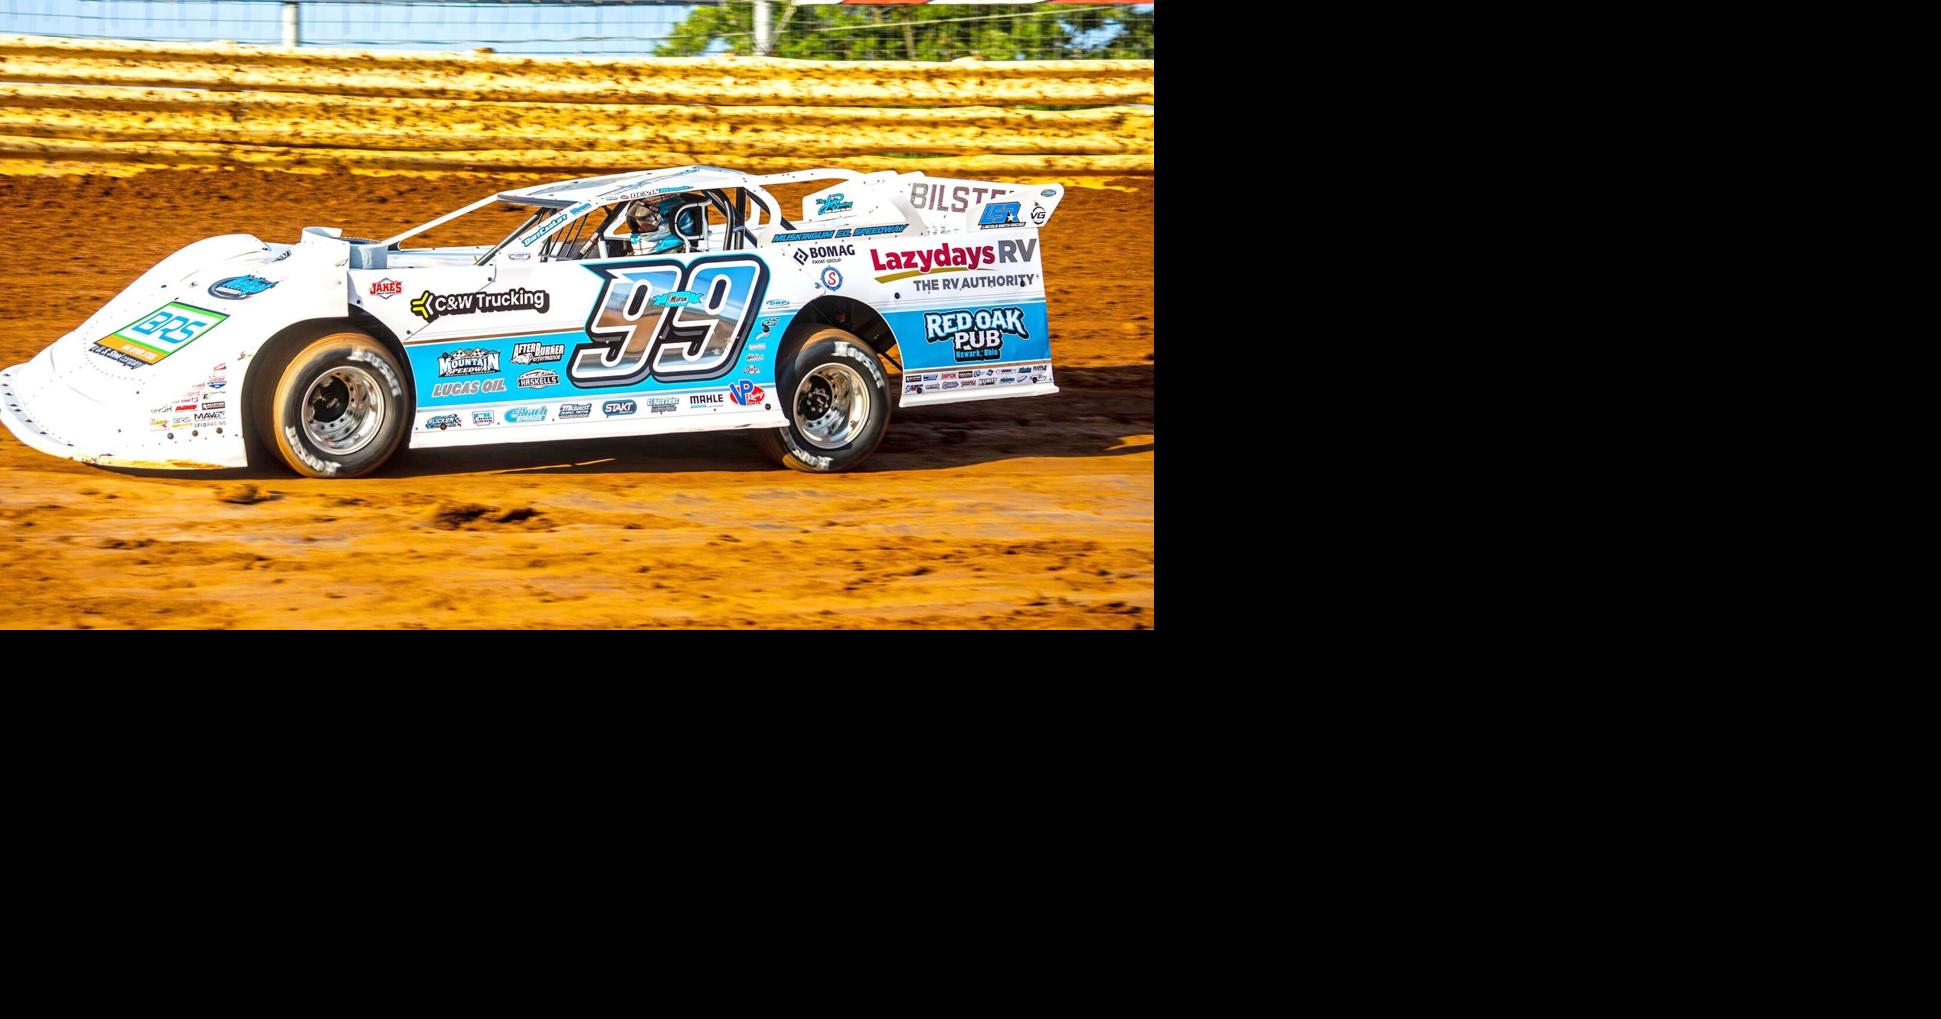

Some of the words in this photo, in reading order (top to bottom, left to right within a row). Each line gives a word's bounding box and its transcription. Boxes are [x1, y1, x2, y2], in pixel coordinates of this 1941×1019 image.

[1030, 211, 1046, 220] VG
[852, 224, 909, 236] SPEEDWAY
[809, 245, 856, 259] BOMAG
[870, 242, 996, 273] Lazydays
[997, 238, 1037, 263] RV
[913, 279, 939, 291] THE
[942, 277, 961, 290] RV
[961, 273, 1035, 289] AUTHORITY
[434, 294, 474, 312] C&W
[476, 290, 545, 309] Trucking
[131, 311, 208, 344] BRS
[566, 252, 770, 389] 99
[925, 312, 974, 339] RED
[974, 308, 1029, 337] OAK
[954, 329, 1001, 350] PUB
[431, 381, 480, 397] LUCAS
[481, 378, 507, 393] OIL
[519, 376, 559, 387] HASKELLS
[690, 394, 724, 404] MAHLE
[729, 379, 754, 406] VP
[605, 402, 634, 413] STAKT
